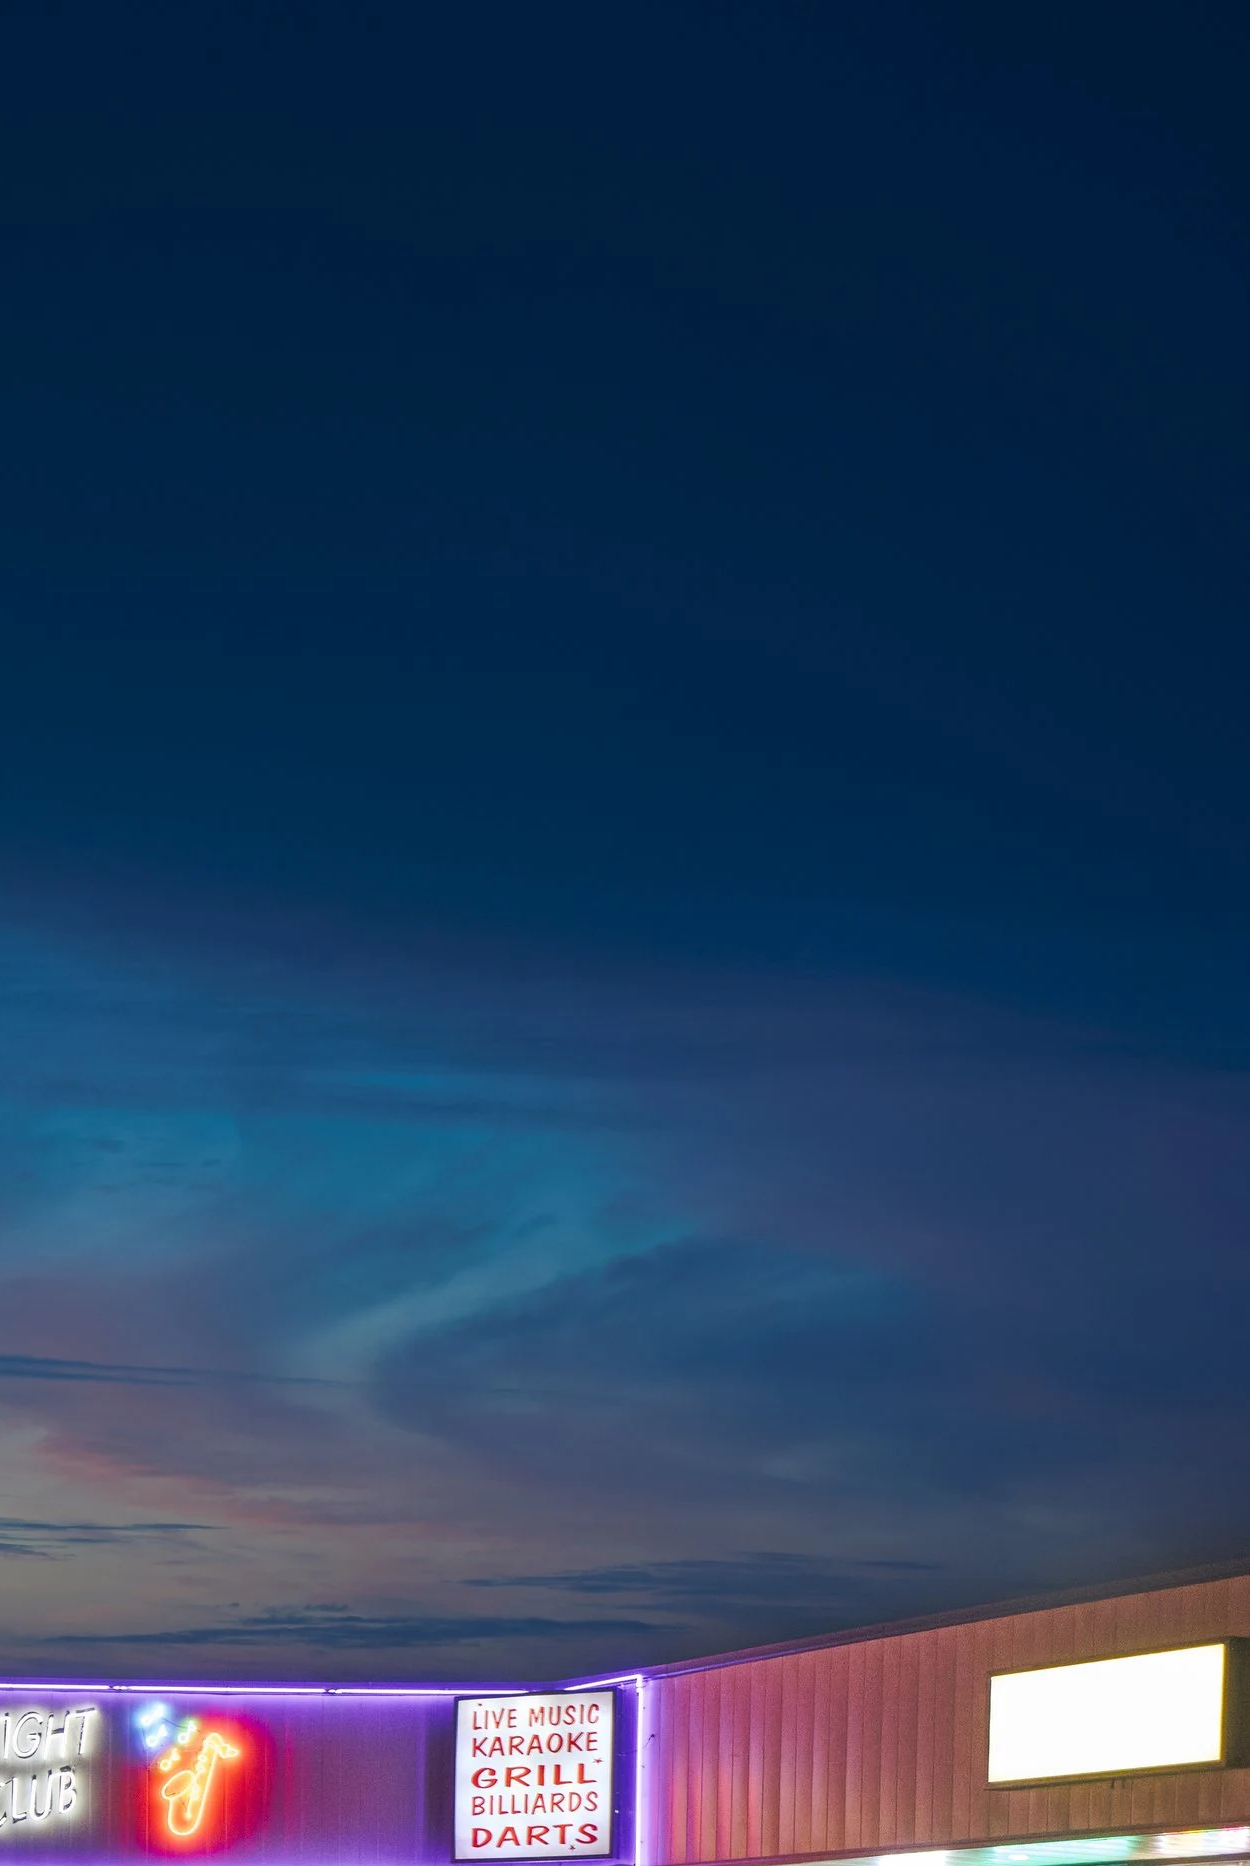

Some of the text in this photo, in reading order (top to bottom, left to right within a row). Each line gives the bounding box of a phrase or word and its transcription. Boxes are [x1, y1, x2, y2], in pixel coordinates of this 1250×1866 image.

[472, 1703, 600, 1731] LIVE MUSIC
[471, 1731, 598, 1758] KARAOKE
[471, 1763, 597, 1789] GRILL
[471, 1790, 598, 1816] BILLIARDS
[471, 1823, 598, 1848] DARTS
